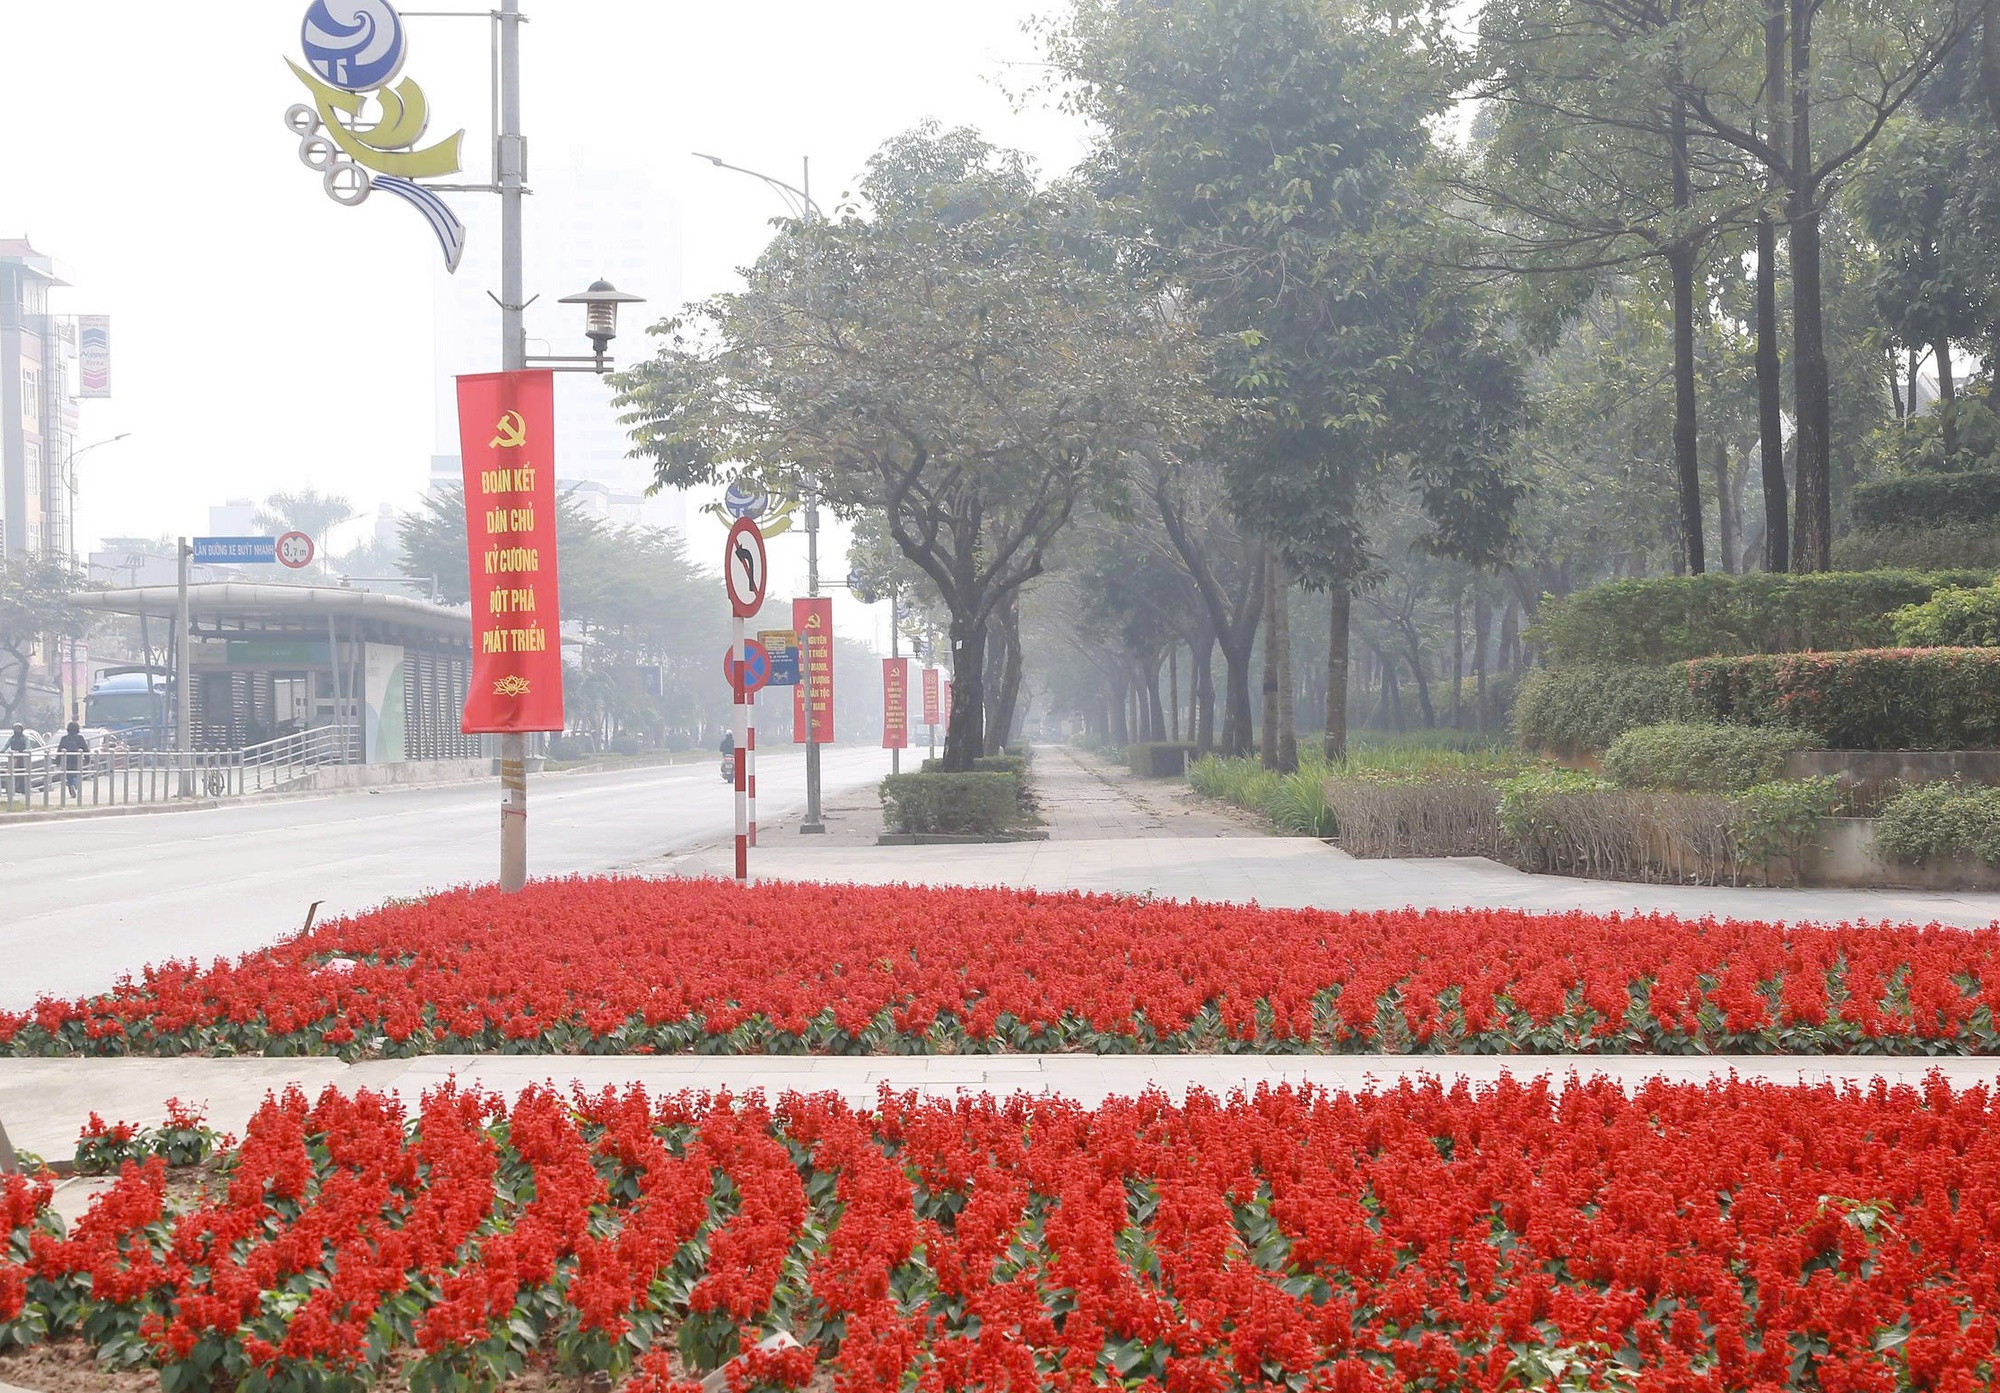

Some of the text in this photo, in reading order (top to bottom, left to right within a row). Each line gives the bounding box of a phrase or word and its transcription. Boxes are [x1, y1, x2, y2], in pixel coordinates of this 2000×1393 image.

[481, 461, 535, 494] ĐOÀN KẾT
[486, 501, 535, 534] DÂN CHỦ
[228, 545, 237, 556] XE
[484, 543, 538, 574] KỶ CƯƠNG
[490, 584, 536, 618] ĐỘT PHÁ
[483, 619, 546, 654] PHÁT TRIỂN
